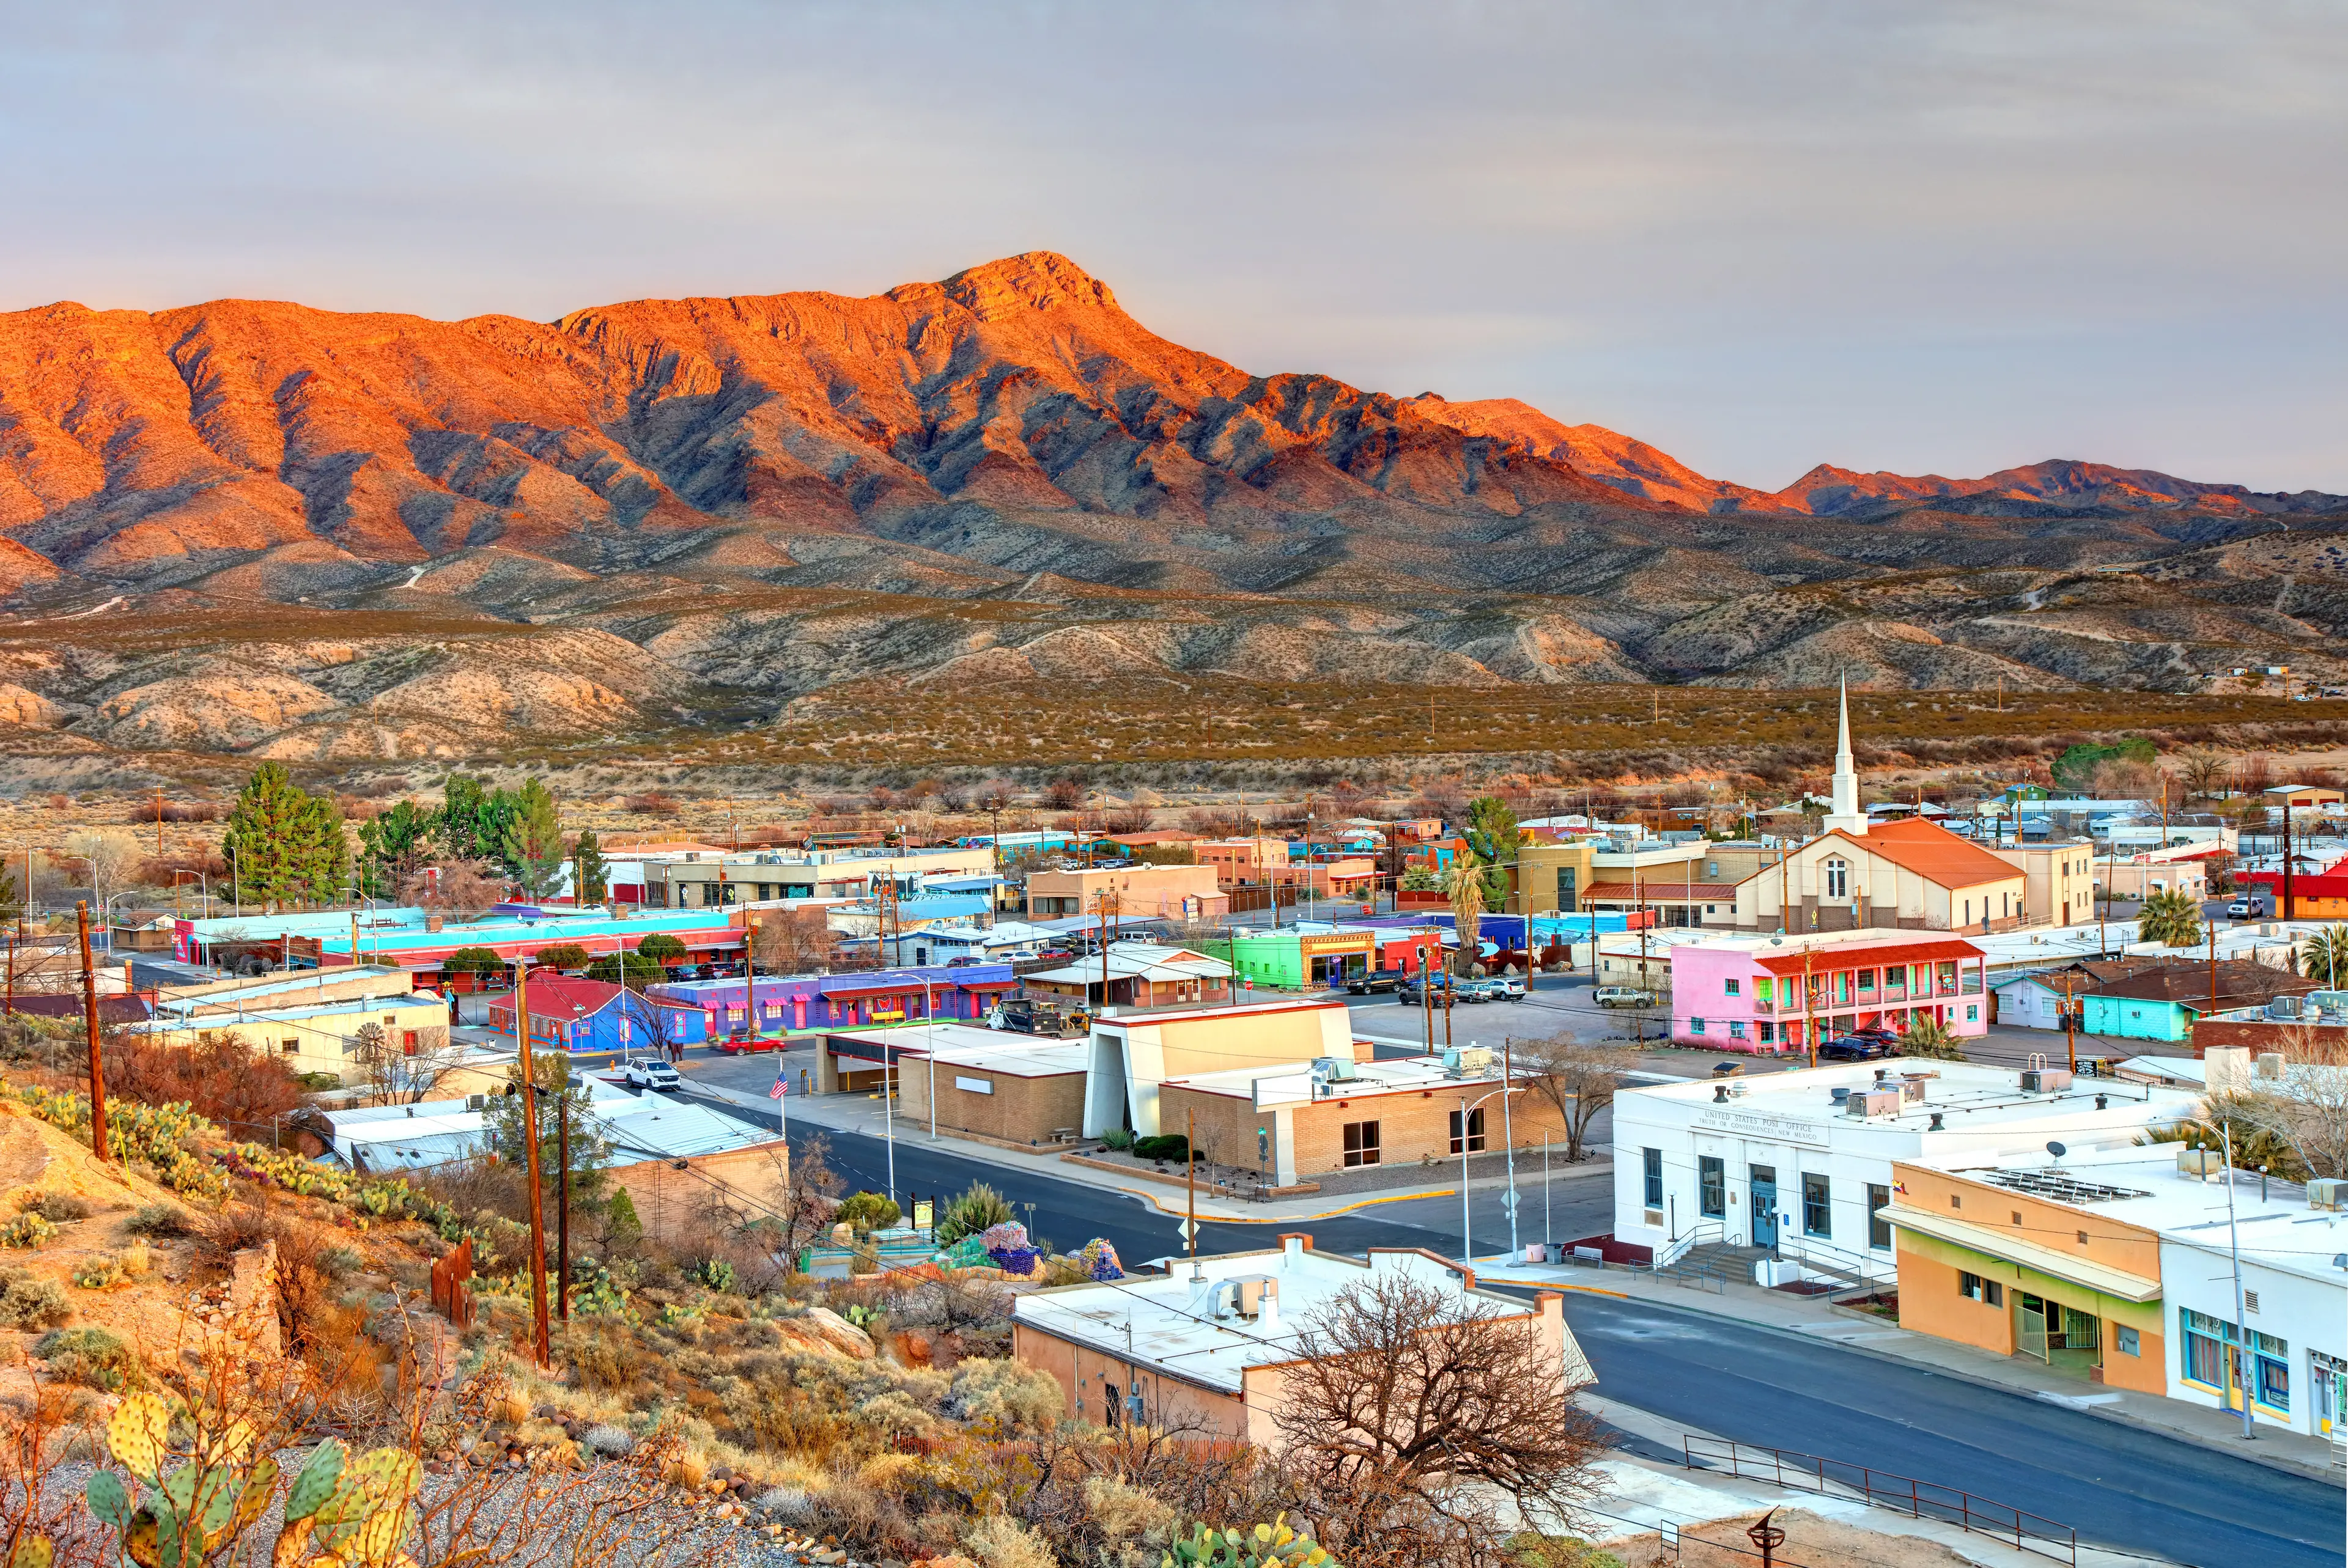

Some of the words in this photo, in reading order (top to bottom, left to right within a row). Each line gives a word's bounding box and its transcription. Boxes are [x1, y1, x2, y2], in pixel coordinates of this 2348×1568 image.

[1705, 1111, 1730, 1121] UNITED
[1735, 1115, 1757, 1124] STATES
[1763, 1119, 1778, 1127] POST
[1786, 1122, 1812, 1132] OFFICE
[1731, 1122, 1774, 1134] CONSEQUENCES
[1794, 1132, 1817, 1140] MEXICO
